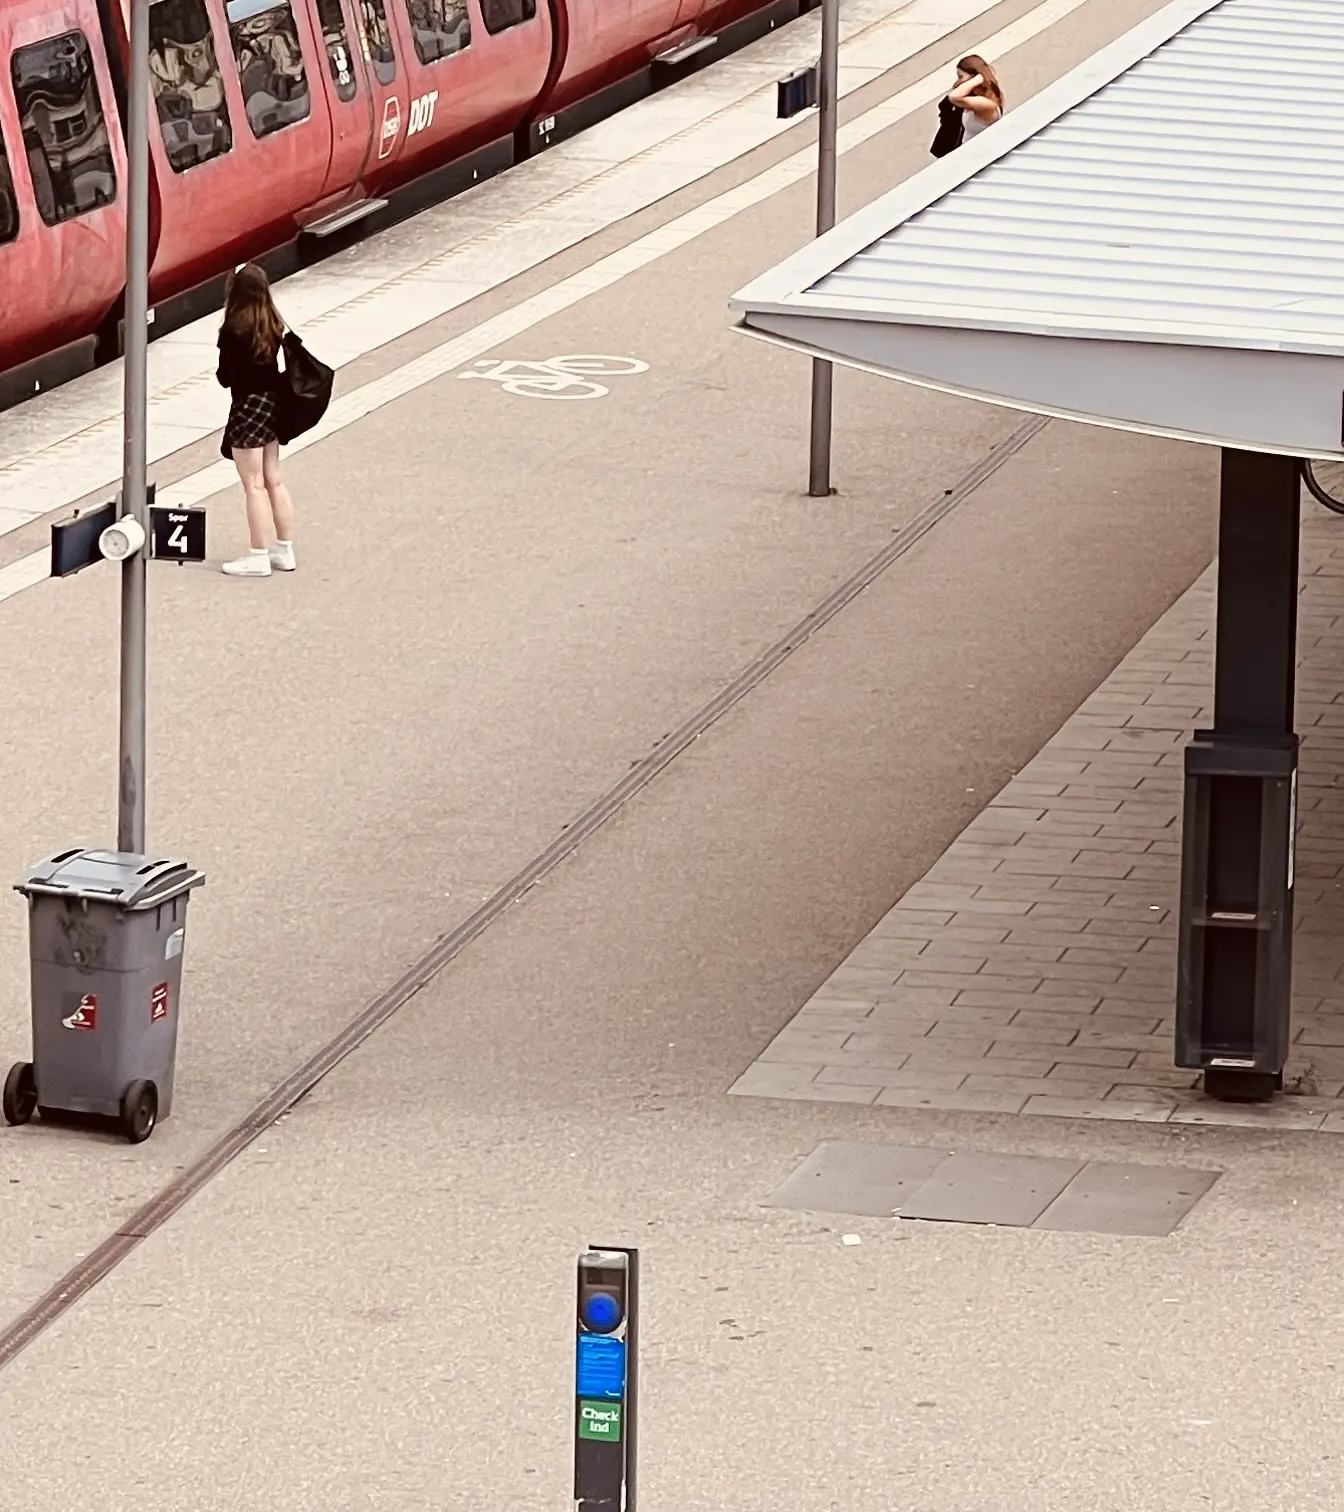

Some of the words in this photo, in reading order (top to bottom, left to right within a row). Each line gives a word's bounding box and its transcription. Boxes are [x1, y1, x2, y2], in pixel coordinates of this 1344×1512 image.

[407, 90, 439, 137] DOT
[167, 524, 188, 553] 4
[581, 1407, 620, 1421] Check
